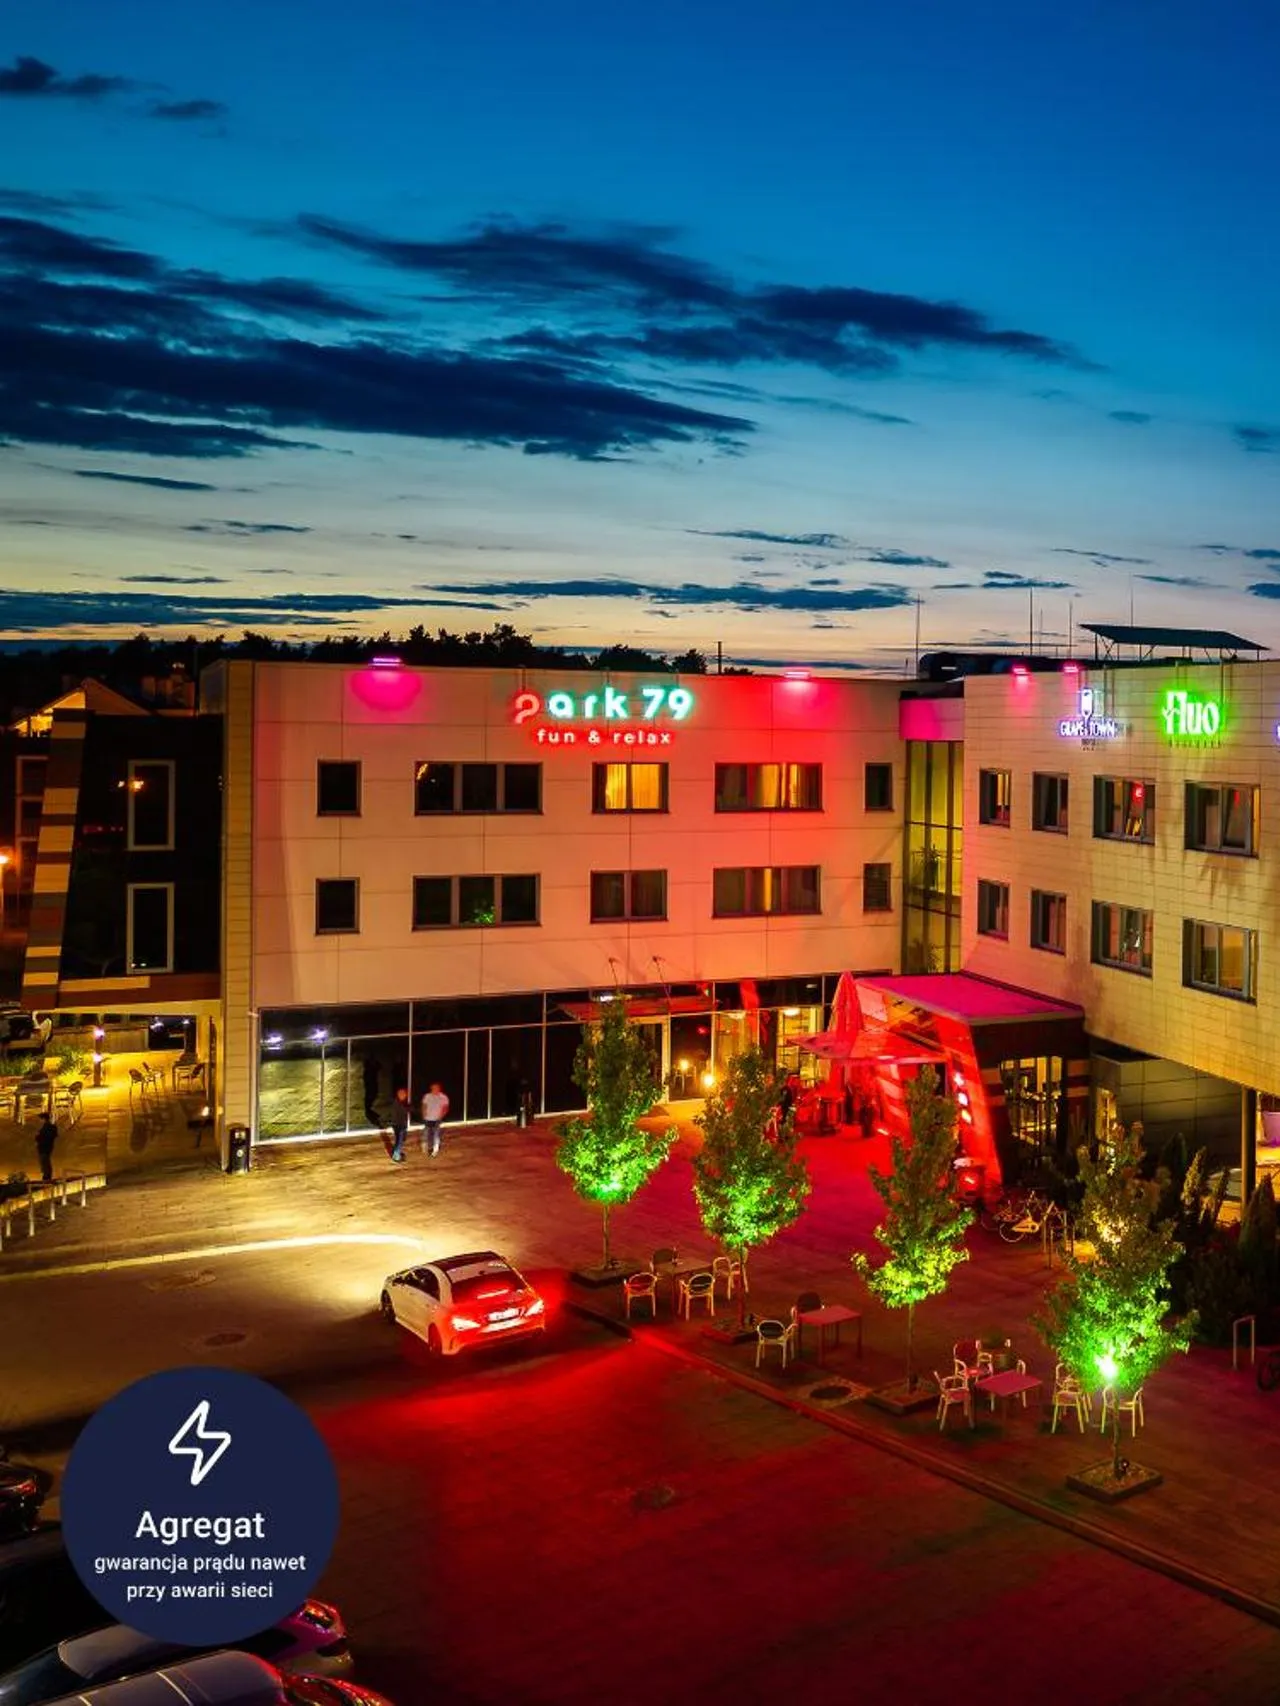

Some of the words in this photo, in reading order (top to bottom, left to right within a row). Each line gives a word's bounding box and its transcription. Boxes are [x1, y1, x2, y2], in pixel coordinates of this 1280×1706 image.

[514, 686, 629, 724] park
[642, 687, 694, 720] 79
[537, 728, 575, 744] fun
[588, 730, 600, 744] &
[613, 729, 671, 745] relax
